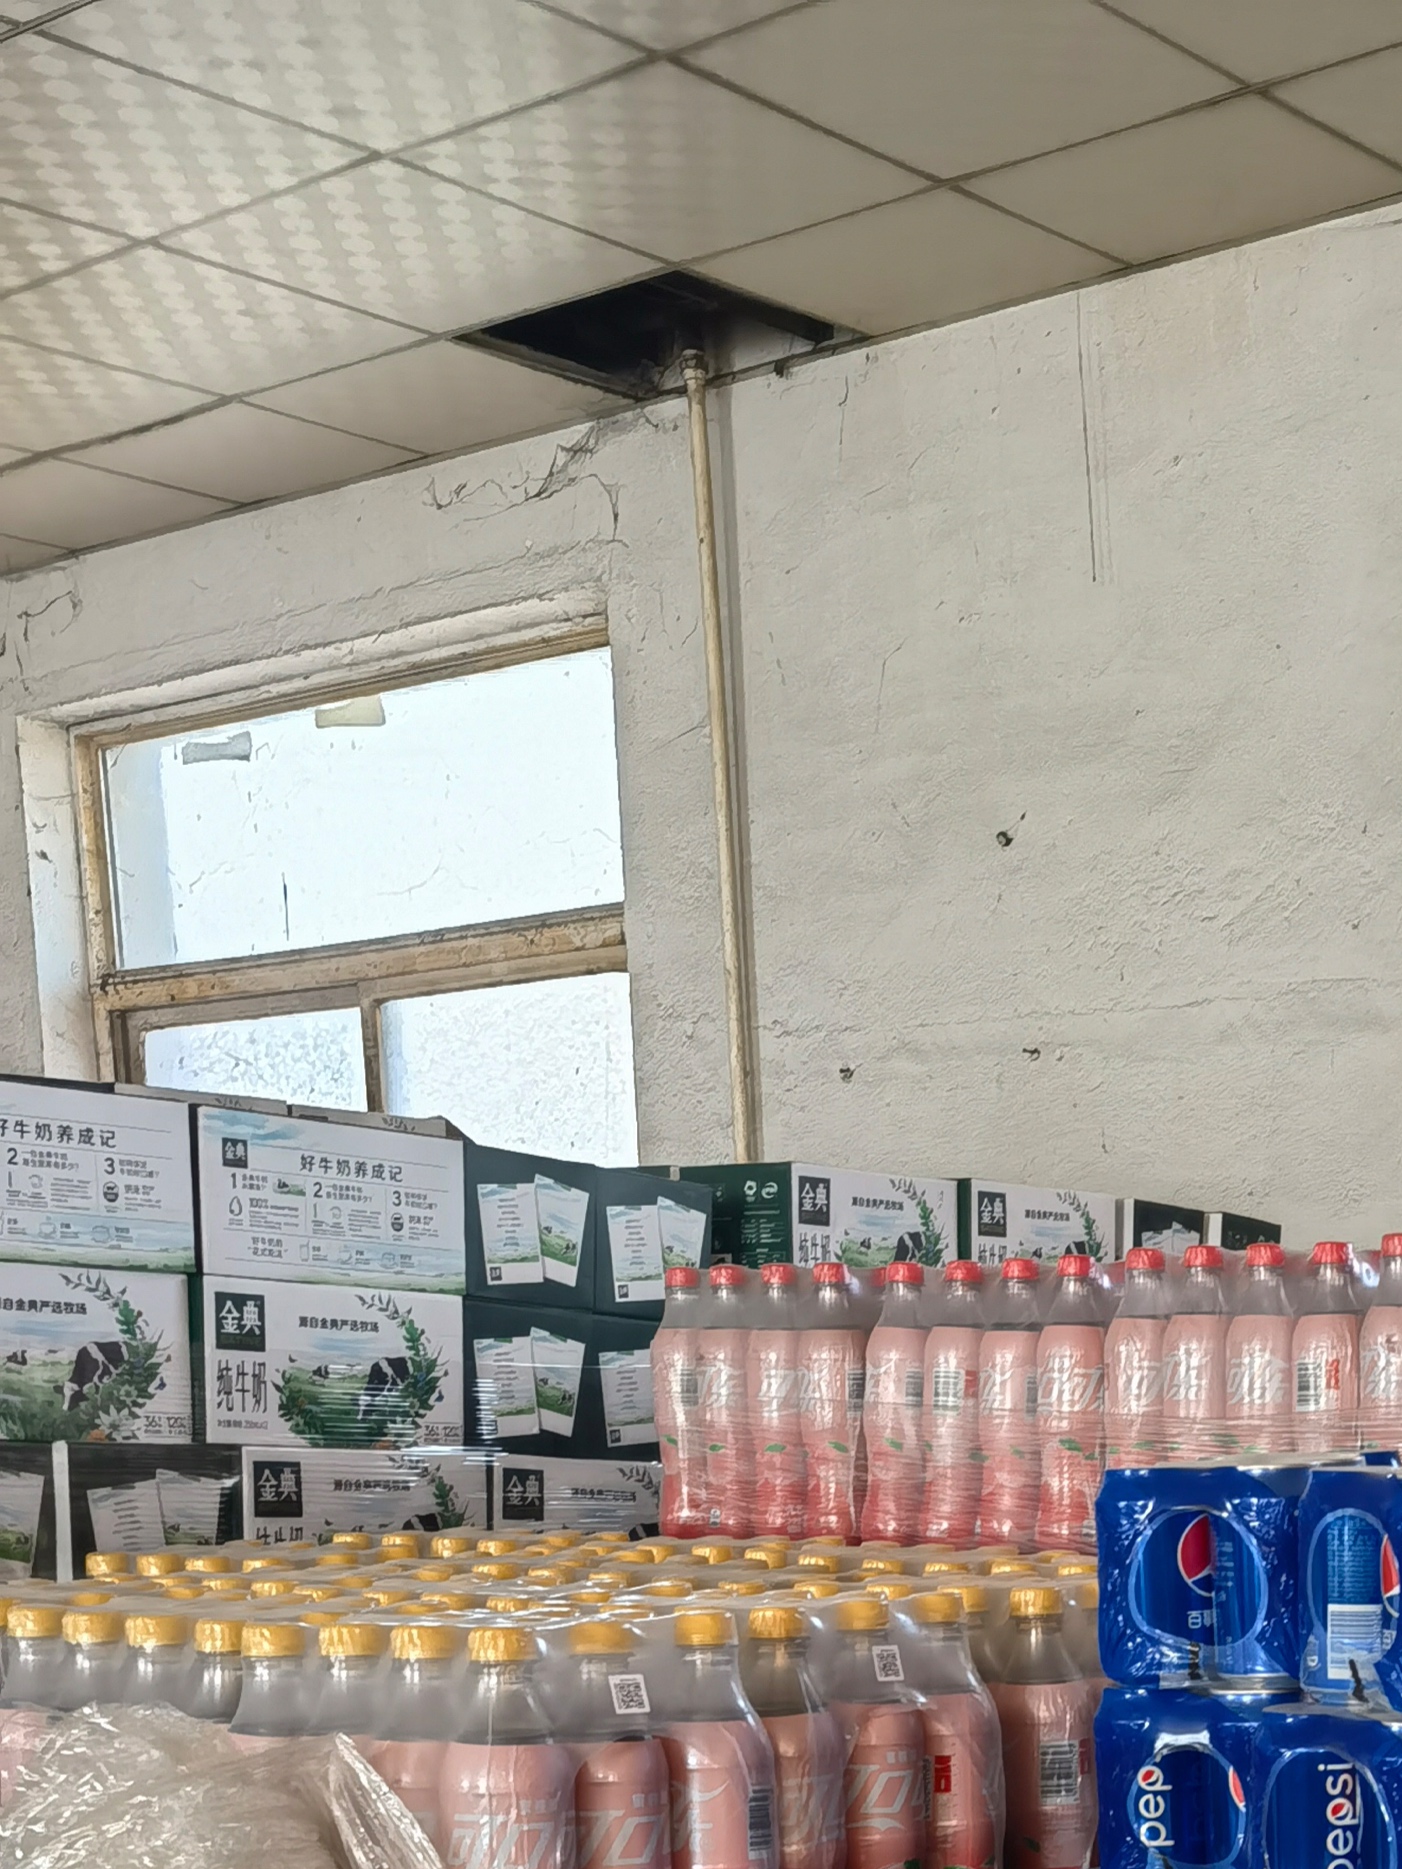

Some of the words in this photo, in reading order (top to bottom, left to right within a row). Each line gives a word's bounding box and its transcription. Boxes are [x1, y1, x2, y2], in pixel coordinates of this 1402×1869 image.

[7, 1148, 18, 1165] 2
[104, 1158, 115, 1175] 3
[299, 1154, 403, 1183] 好牛奶养成记
[313, 1182, 323, 1198] 2
[392, 1191, 402, 1206] 3
[801, 1183, 828, 1213] 金典
[979, 1197, 1006, 1224] 金典
[0, 1298, 87, 1315] 自金典严选牧场
[219, 1300, 263, 1335] 金典
[217, 1360, 268, 1413] 纯牛奶
[258, 1468, 298, 1501] 金典
[506, 1476, 542, 1506] 金典
[1139, 1757, 1173, 1848] pep
